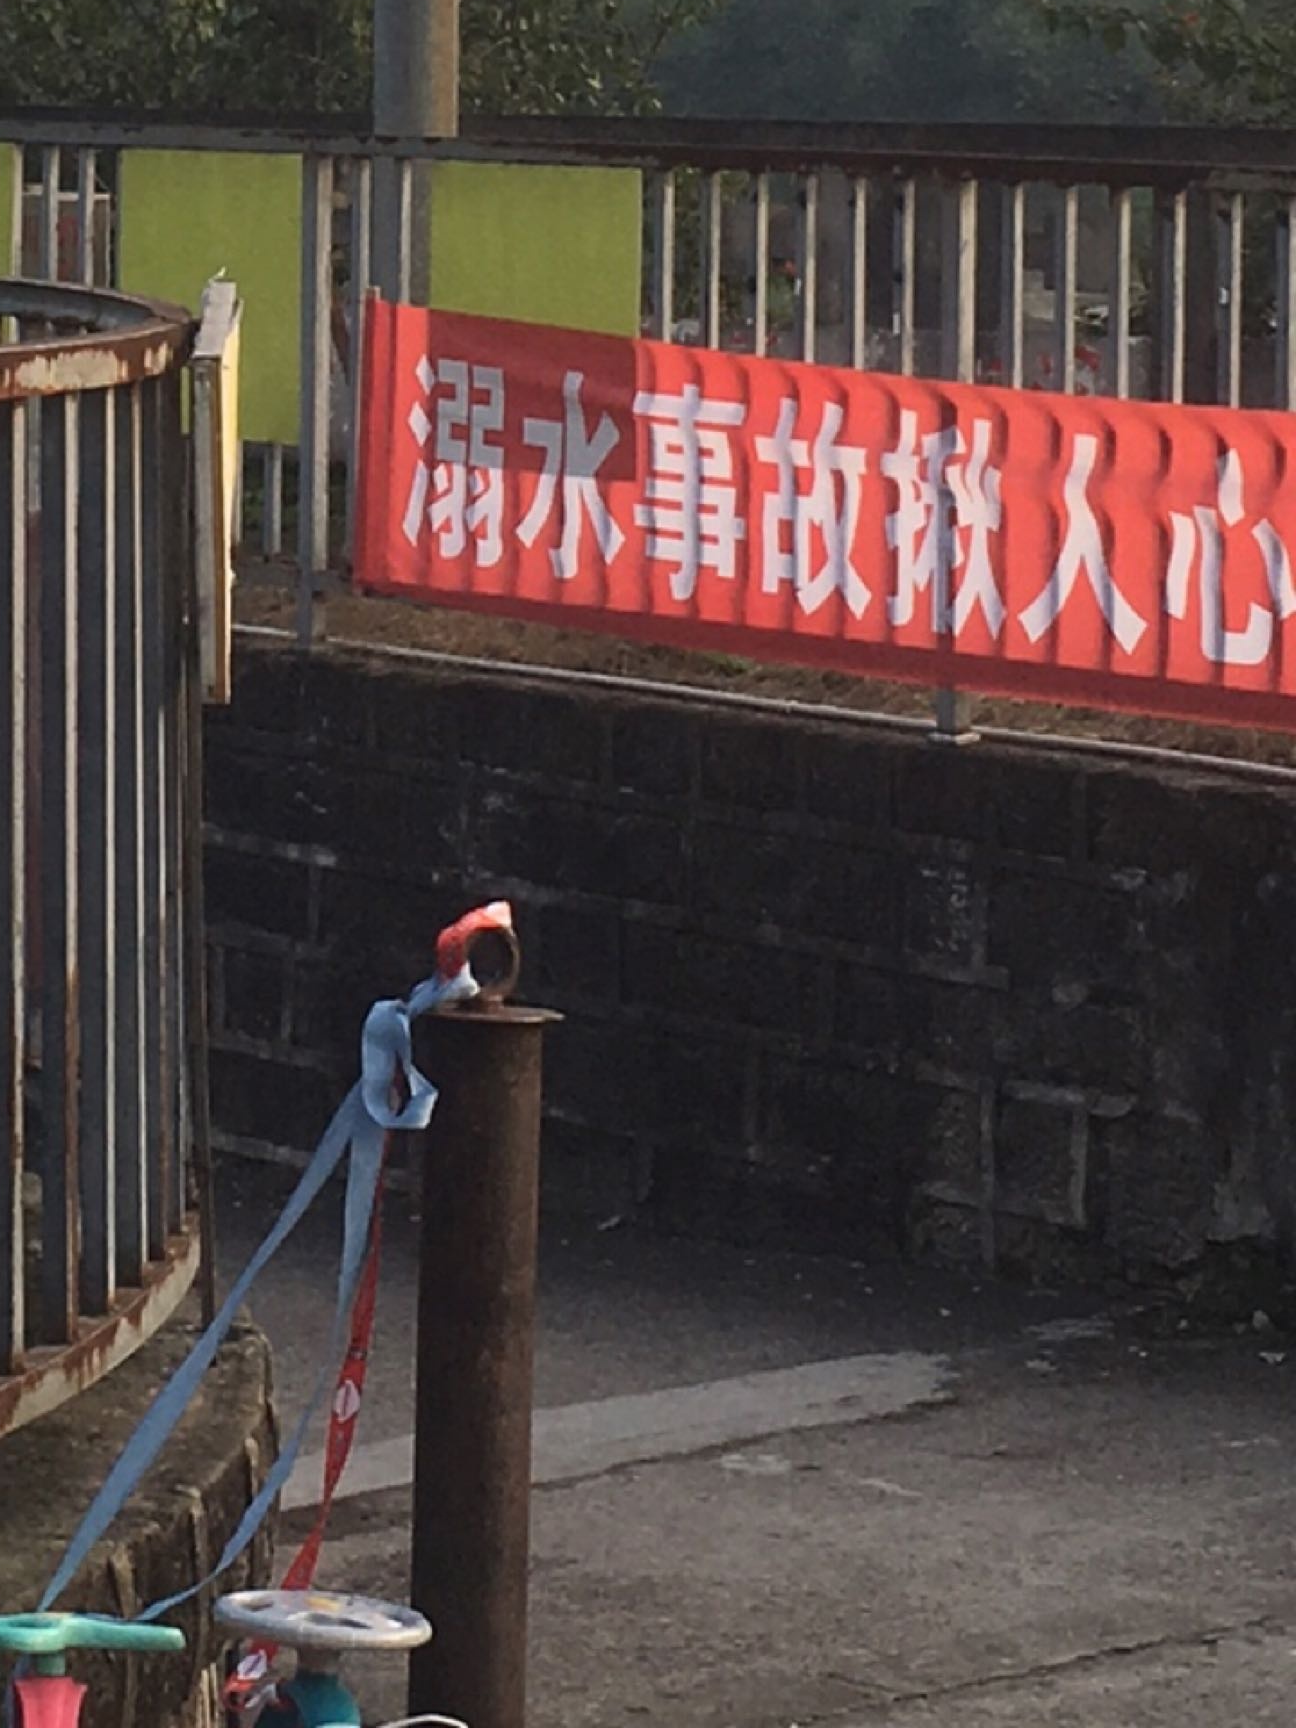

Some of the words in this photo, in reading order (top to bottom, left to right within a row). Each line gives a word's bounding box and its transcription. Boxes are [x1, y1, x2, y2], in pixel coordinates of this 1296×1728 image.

[402, 354, 1296, 666] 溺水事故揪人心
